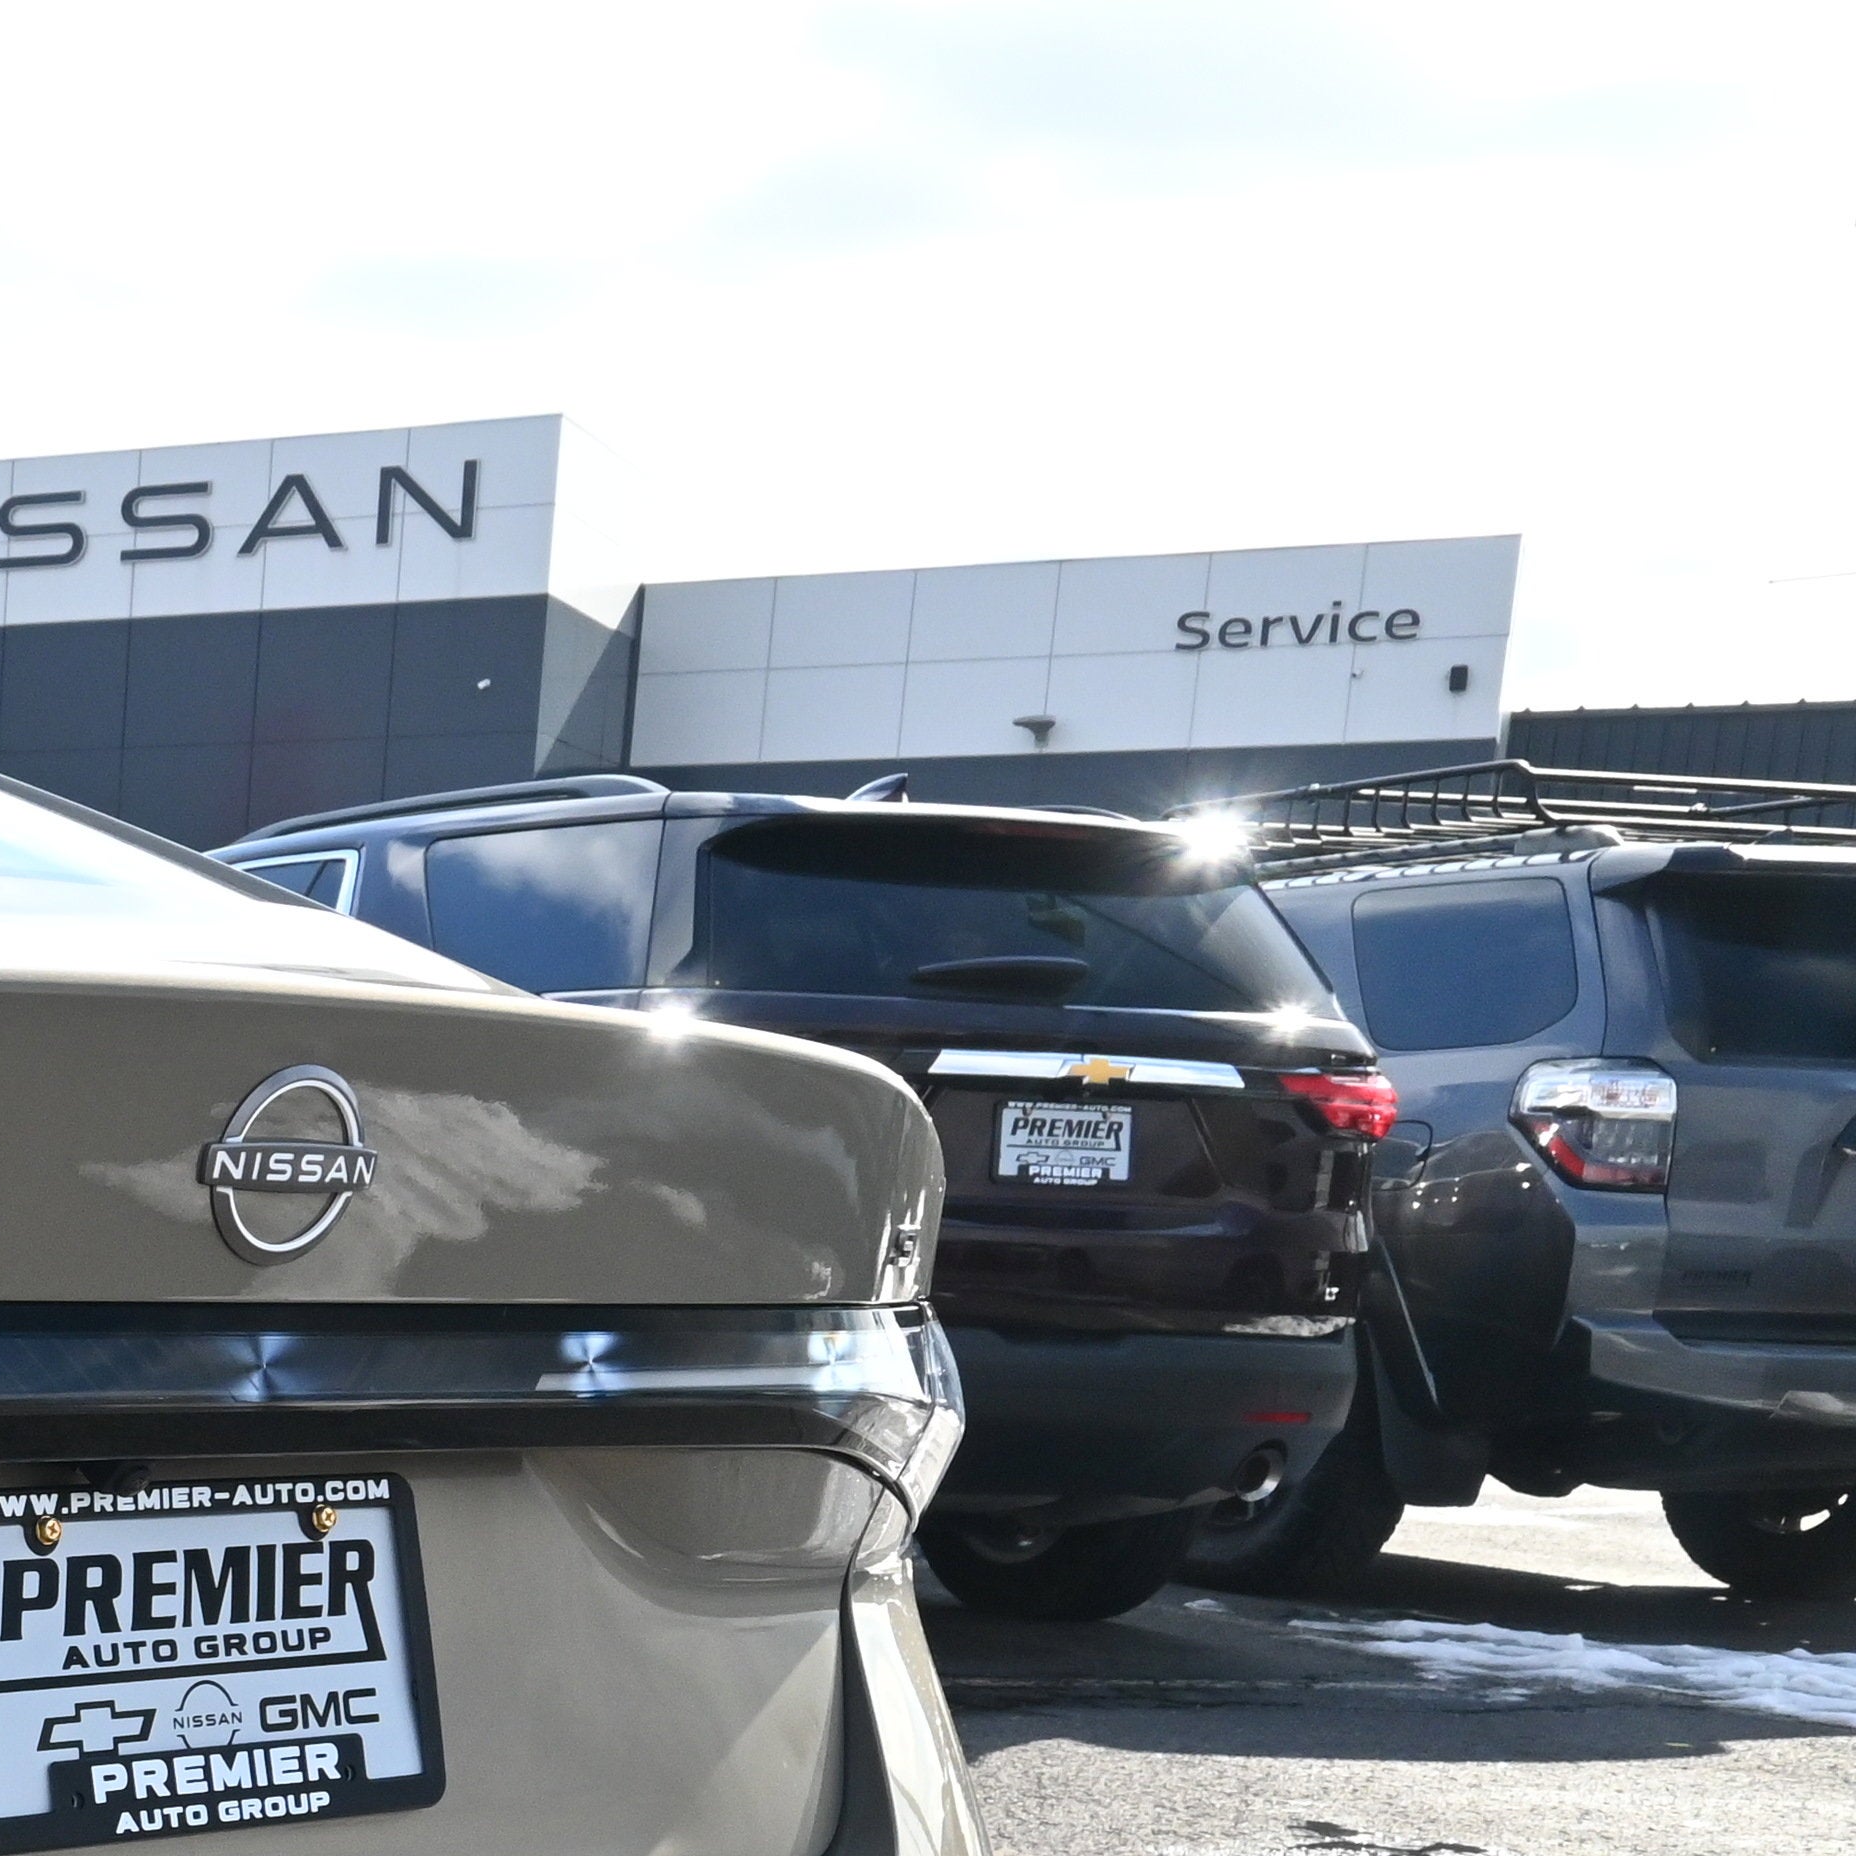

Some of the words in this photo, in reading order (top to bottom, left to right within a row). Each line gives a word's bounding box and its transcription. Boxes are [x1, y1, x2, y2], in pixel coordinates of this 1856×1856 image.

[1175, 601, 1420, 650] Service
[1011, 1117, 1123, 1151] PREMIER
[1026, 1138, 1059, 1146] AUTO
[212, 1151, 375, 1184] NISSAN
[1029, 1166, 1102, 1178] PREMIER
[1079, 1156, 1116, 1166] GMC
[0, 1539, 387, 1661] PREMIER
[62, 1638, 178, 1670] AUTO
[194, 1626, 331, 1659] GROUP
[172, 1708, 243, 1730] NISSAN
[259, 1687, 380, 1733] GMC
[90, 1742, 341, 1805] PREMIER
[115, 1805, 208, 1834] AUTO
[218, 1791, 331, 1831] GROUP
